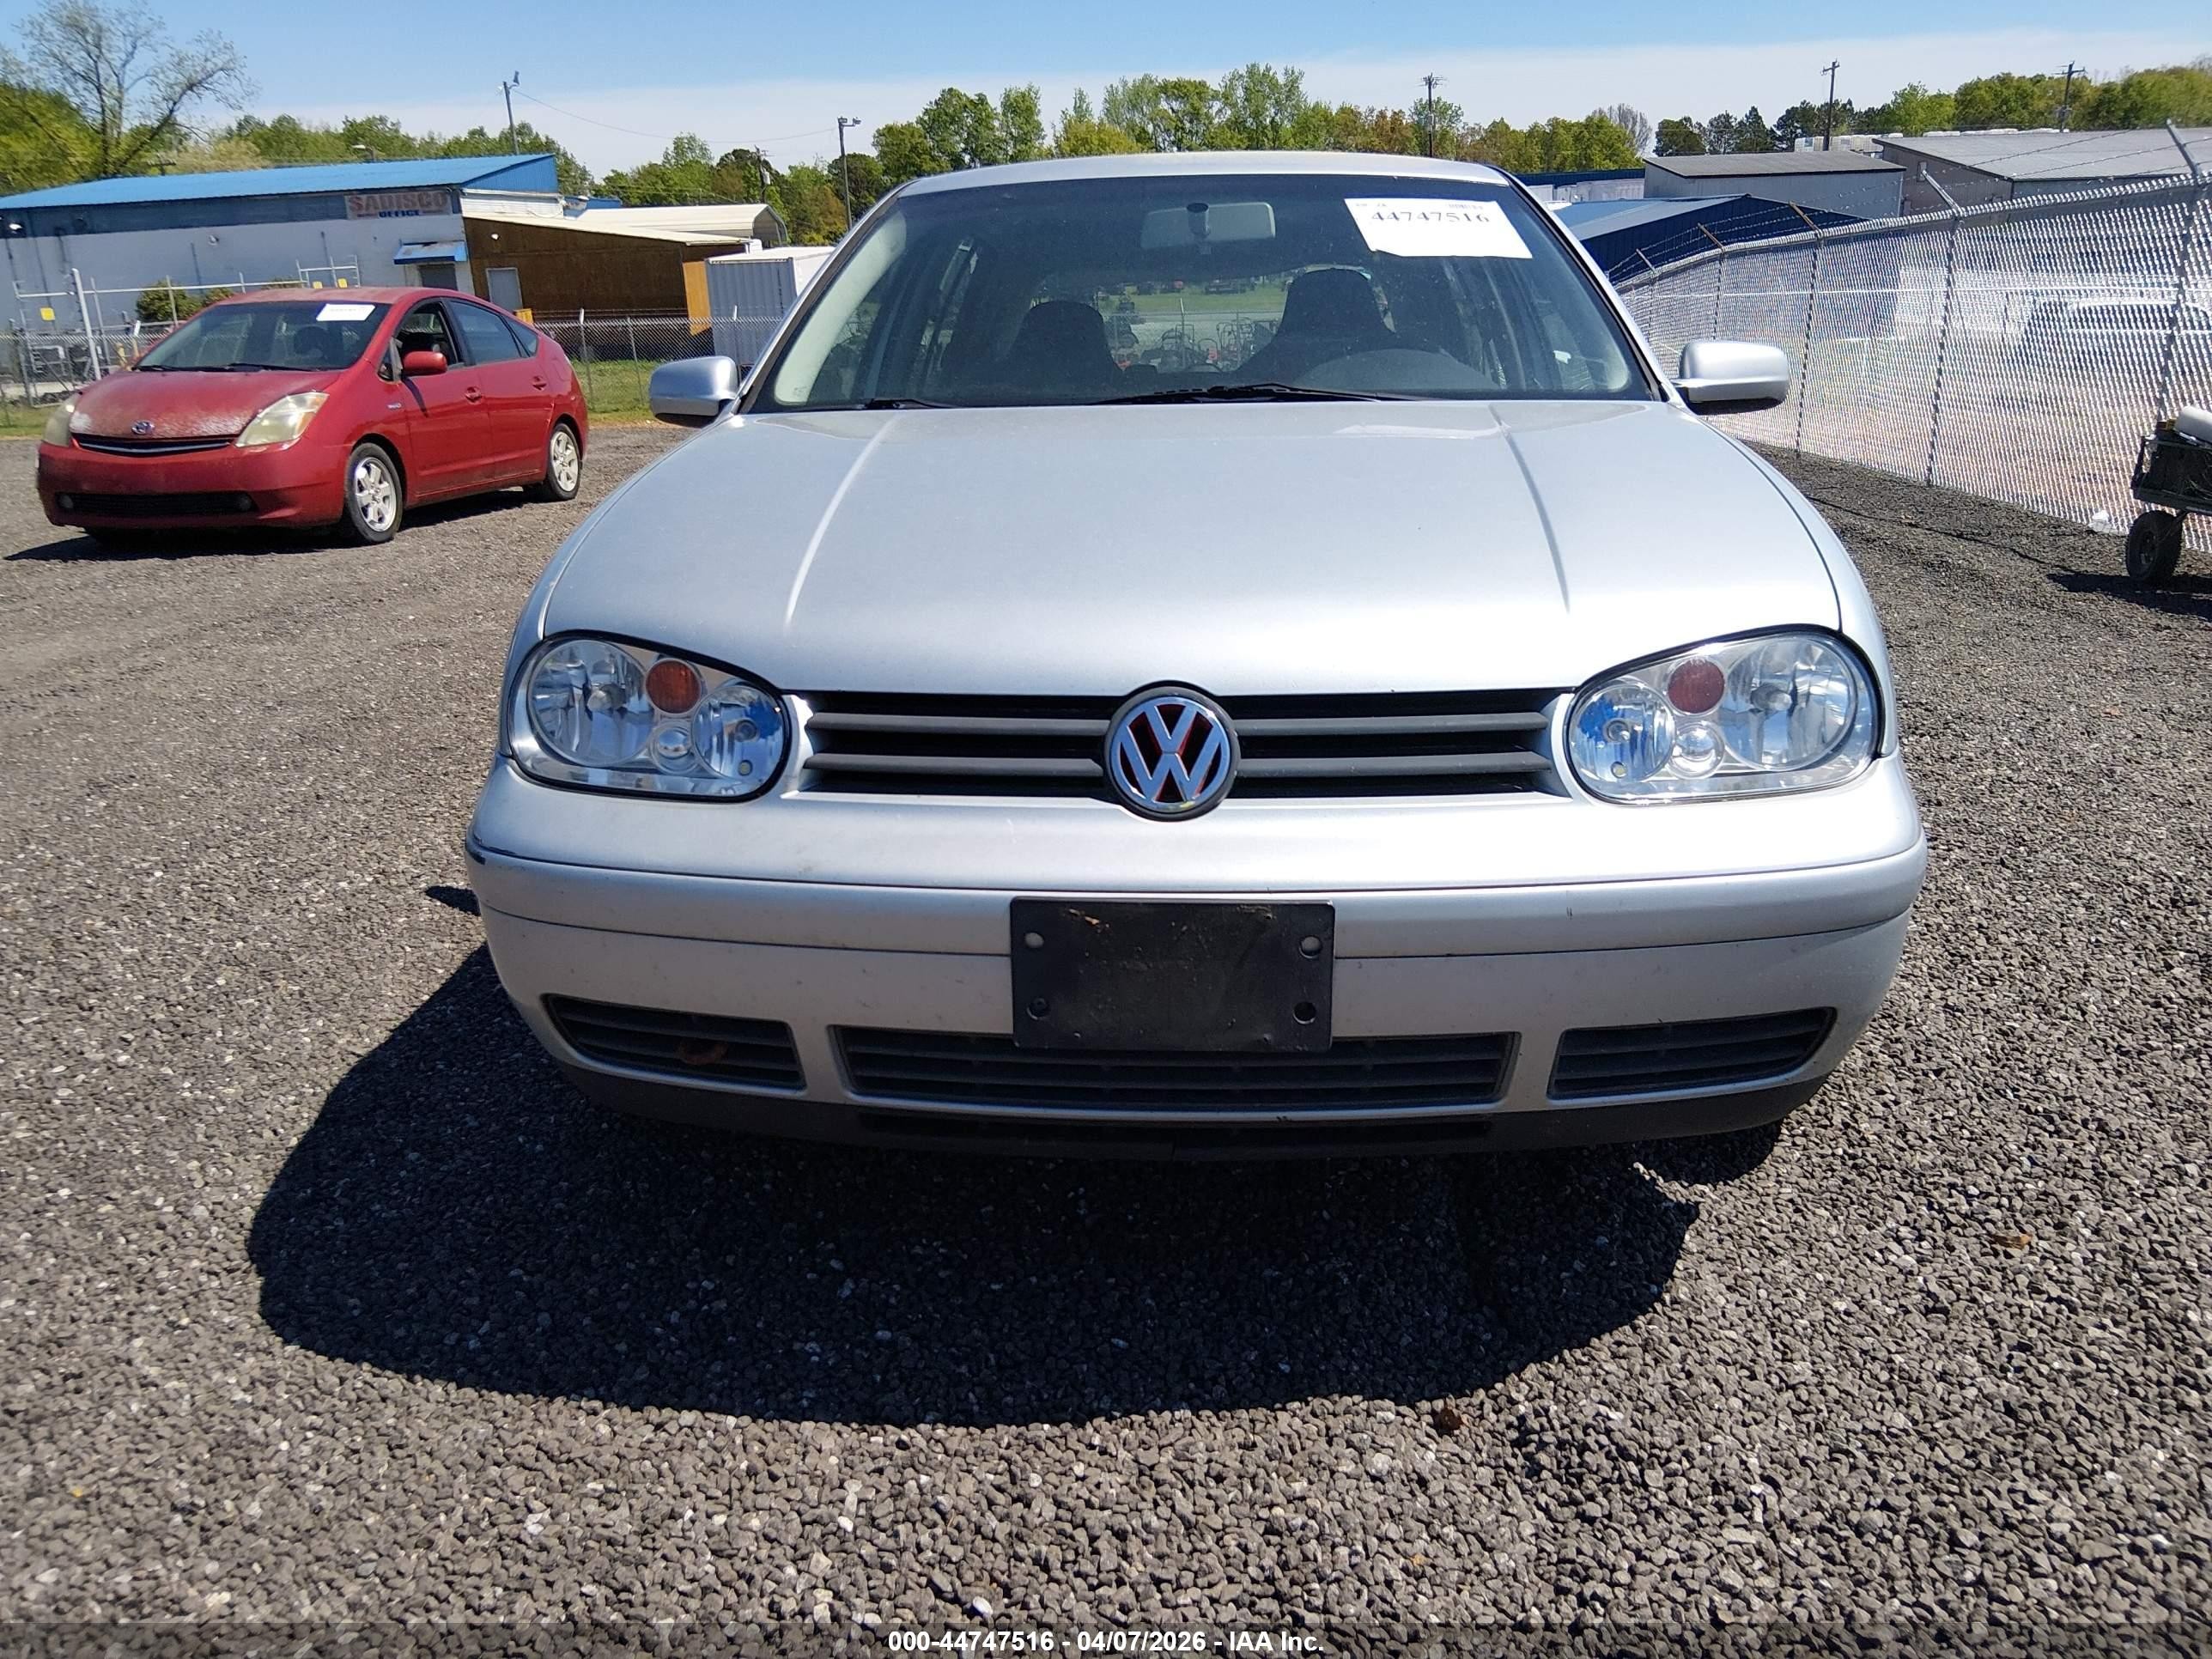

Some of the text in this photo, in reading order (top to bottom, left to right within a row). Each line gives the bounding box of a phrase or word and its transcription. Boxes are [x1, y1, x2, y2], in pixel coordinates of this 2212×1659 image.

[349, 191, 448, 211] SADISCO
[1371, 211, 1490, 223] 44747516
[1113, 700, 1230, 810] VW
